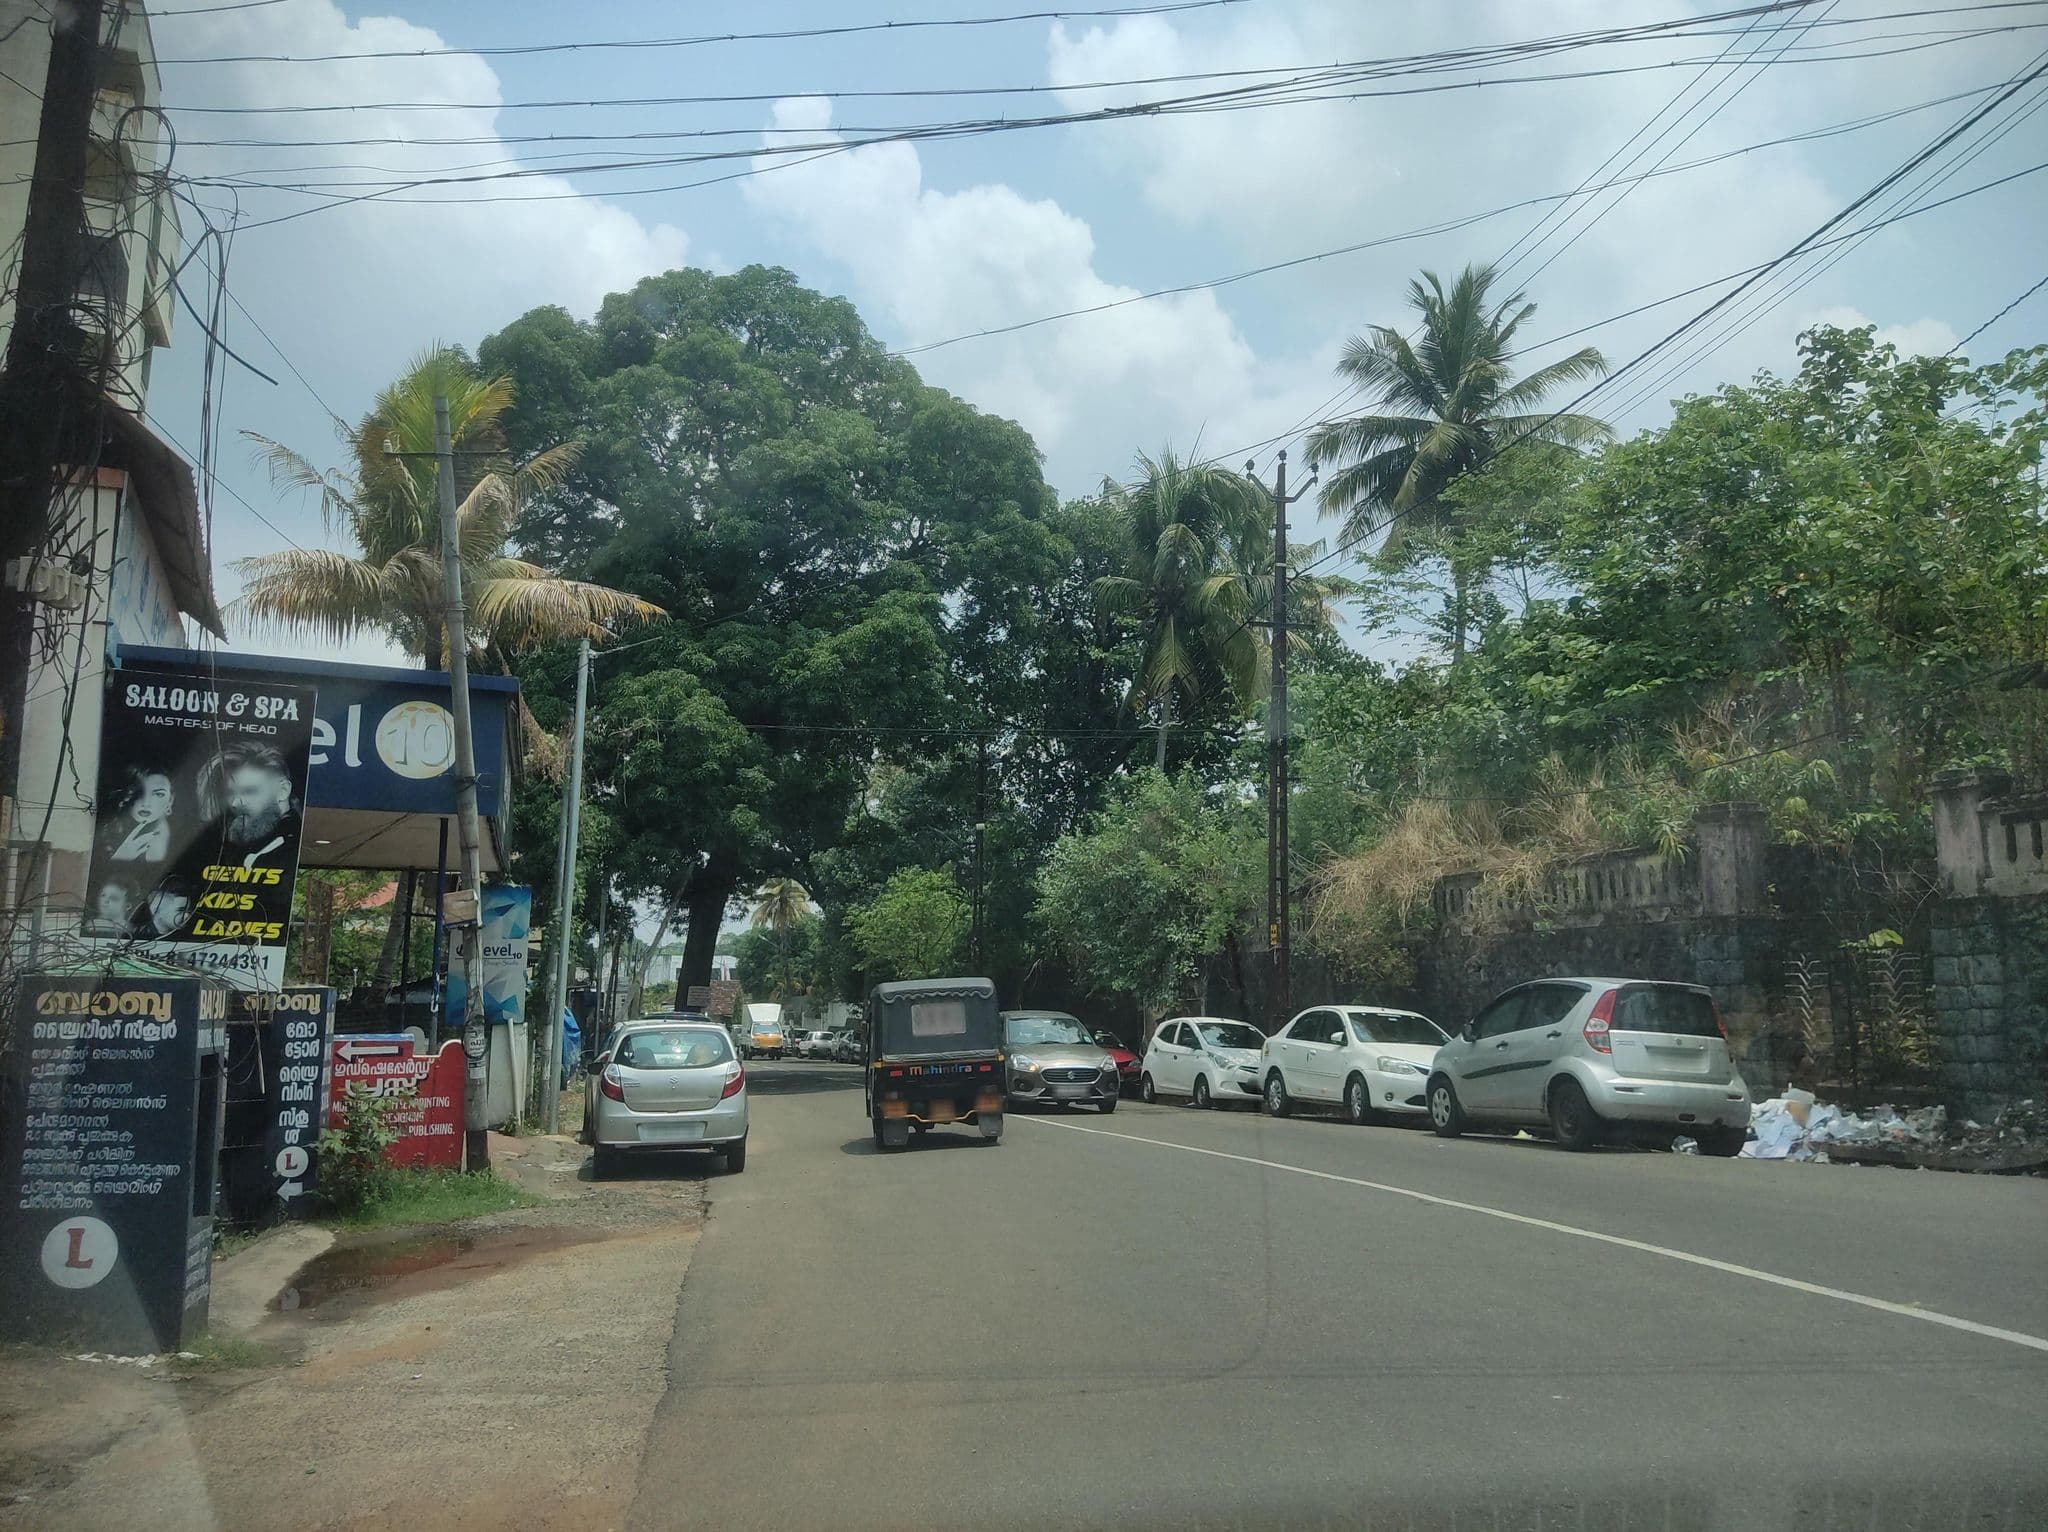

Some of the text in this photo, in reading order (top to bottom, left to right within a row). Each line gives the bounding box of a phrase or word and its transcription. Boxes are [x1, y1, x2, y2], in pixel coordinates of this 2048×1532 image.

[125, 684, 299, 721] SALOON & SPA
[144, 714, 277, 735] MASTERS OF HEAD
[386, 722, 452, 767] 10
[202, 864, 284, 885] GENTS
[198, 891, 258, 910] KIDS
[192, 918, 284, 939] LADIES
[36, 992, 173, 1023] ബാബു
[200, 990, 227, 1020] BABU
[284, 1152, 298, 1170] L
[65, 1228, 94, 1269] L
